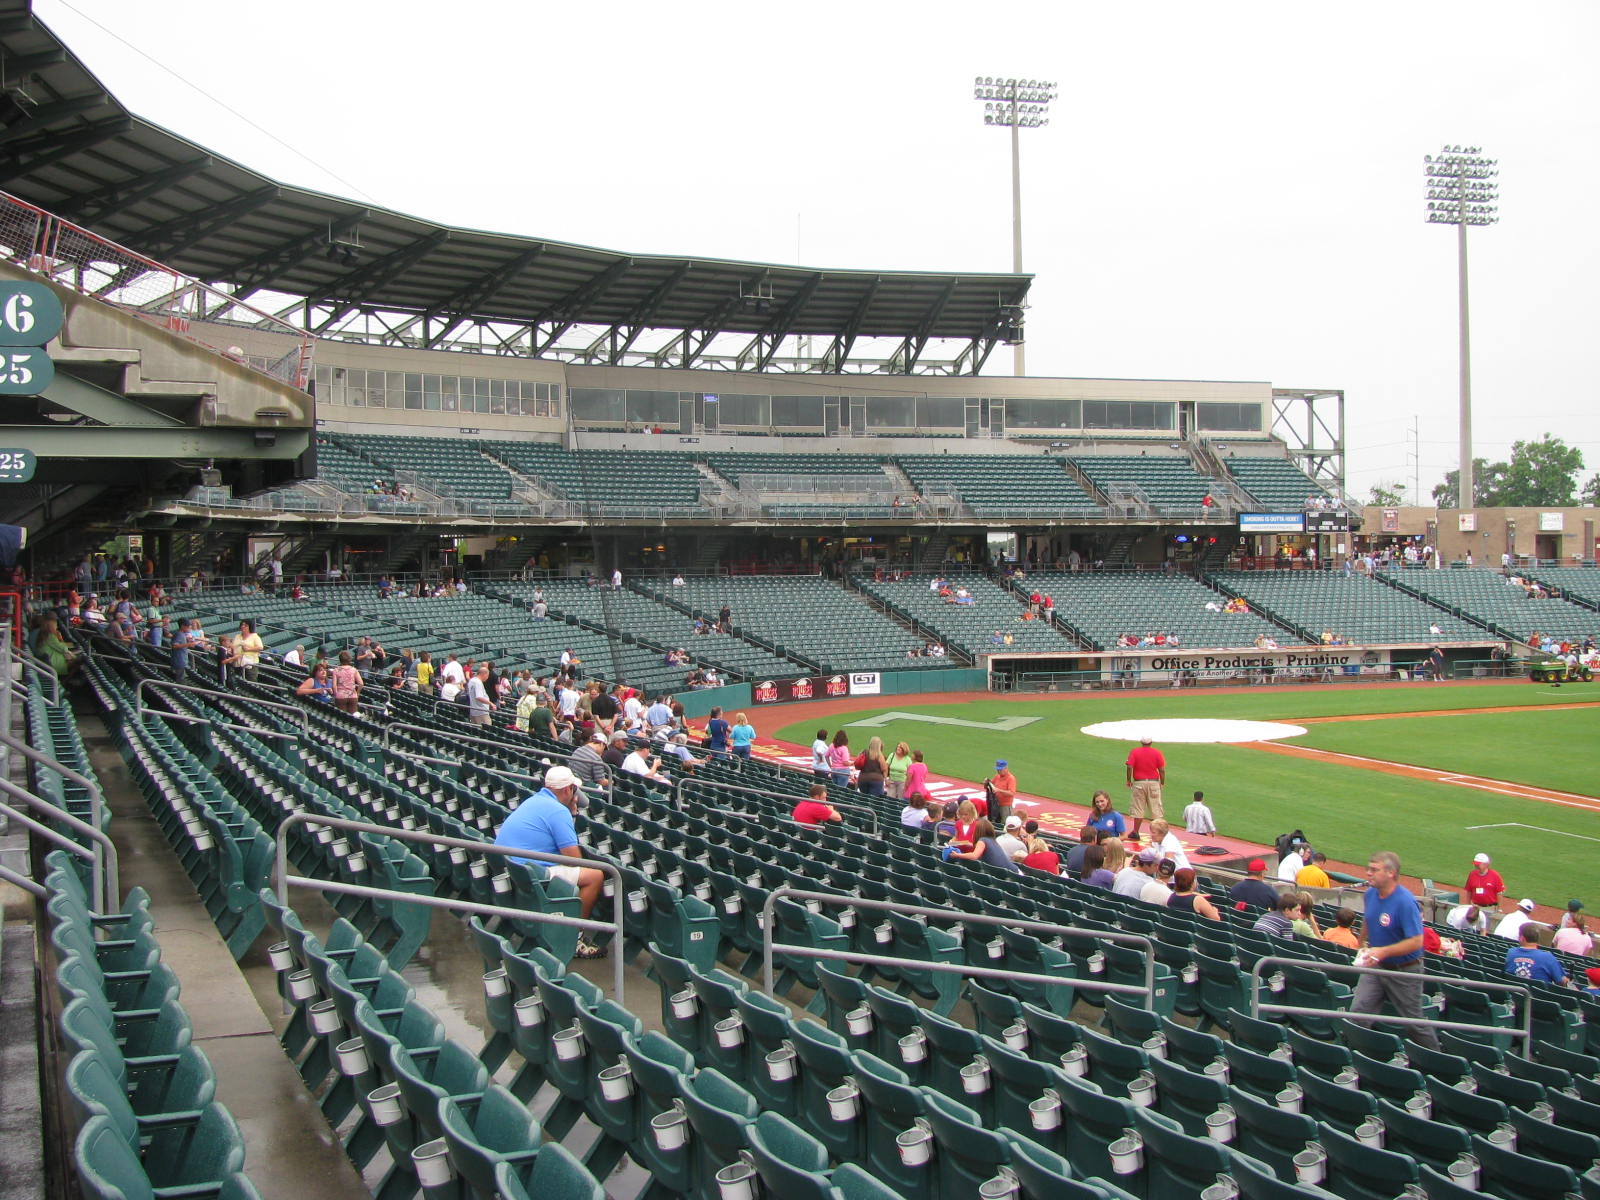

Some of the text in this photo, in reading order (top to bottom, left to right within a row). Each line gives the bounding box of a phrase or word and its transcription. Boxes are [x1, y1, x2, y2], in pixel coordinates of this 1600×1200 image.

[0, 294, 35, 333] 6
[1152, 656, 1200, 670] Office
[1204, 655, 1275, 669] Products
[1286, 653, 1350, 667] Printing
[855, 675, 875, 684] CST
